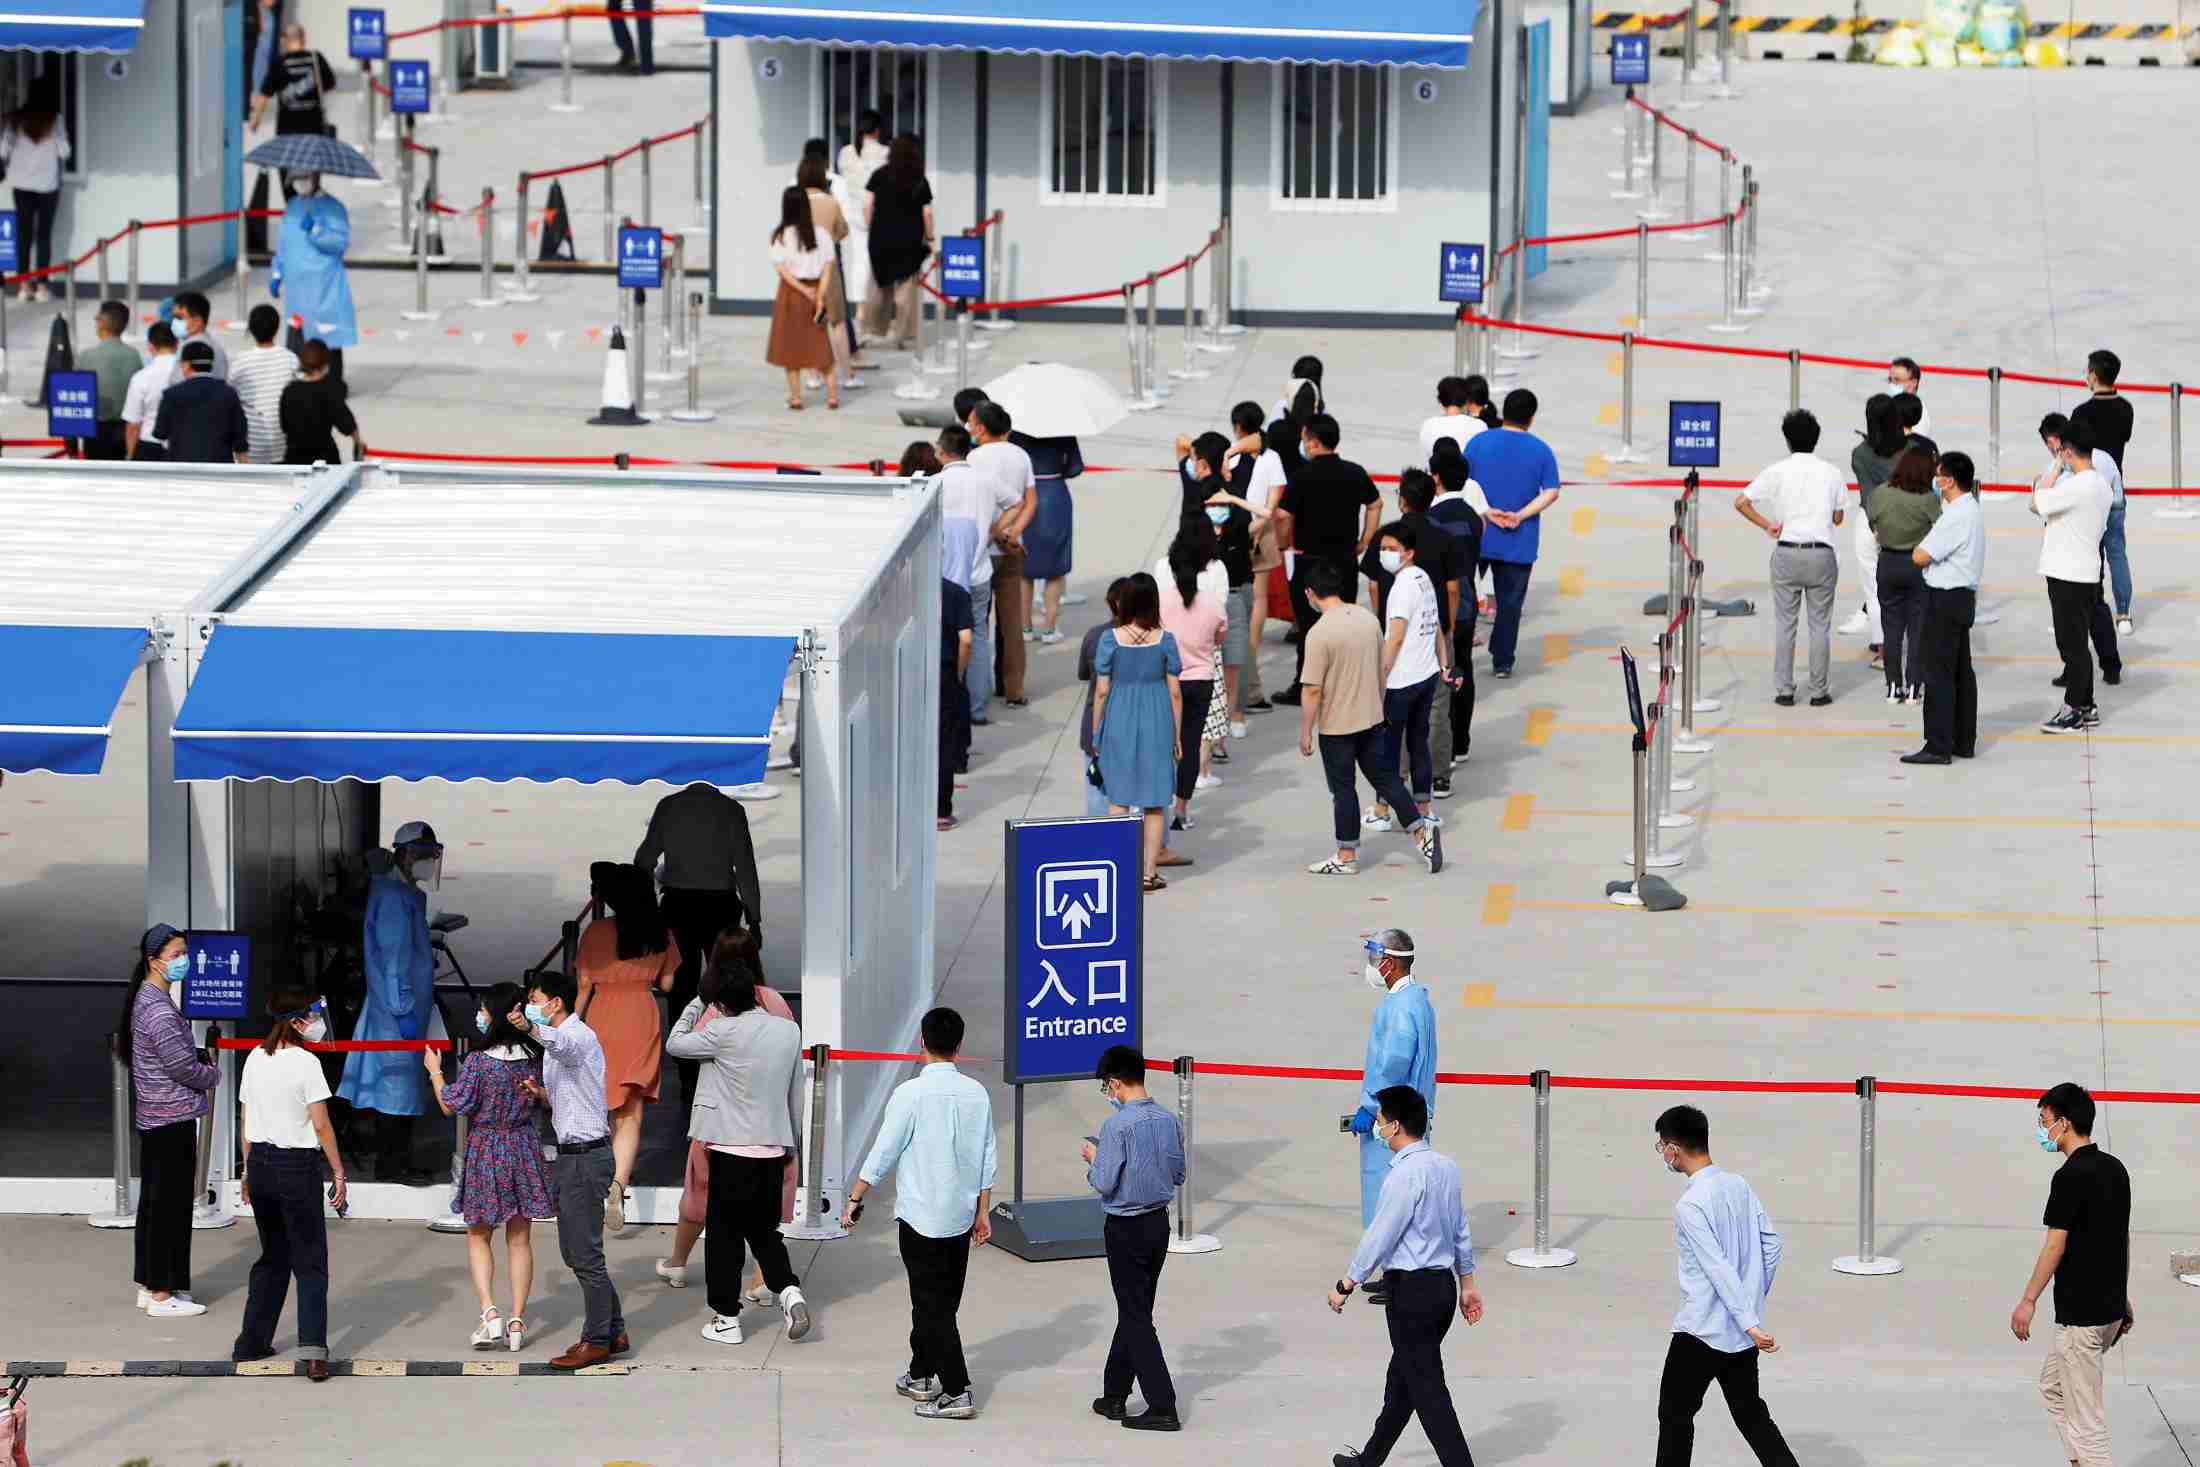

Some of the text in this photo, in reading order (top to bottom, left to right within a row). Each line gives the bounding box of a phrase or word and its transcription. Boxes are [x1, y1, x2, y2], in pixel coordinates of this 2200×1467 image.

[111, 60, 124, 76] 4
[765, 59, 777, 78] 5
[1420, 81, 1432, 99] 6
[1026, 959, 1127, 1008] 入口
[1025, 1015, 1127, 1039] Entrance
